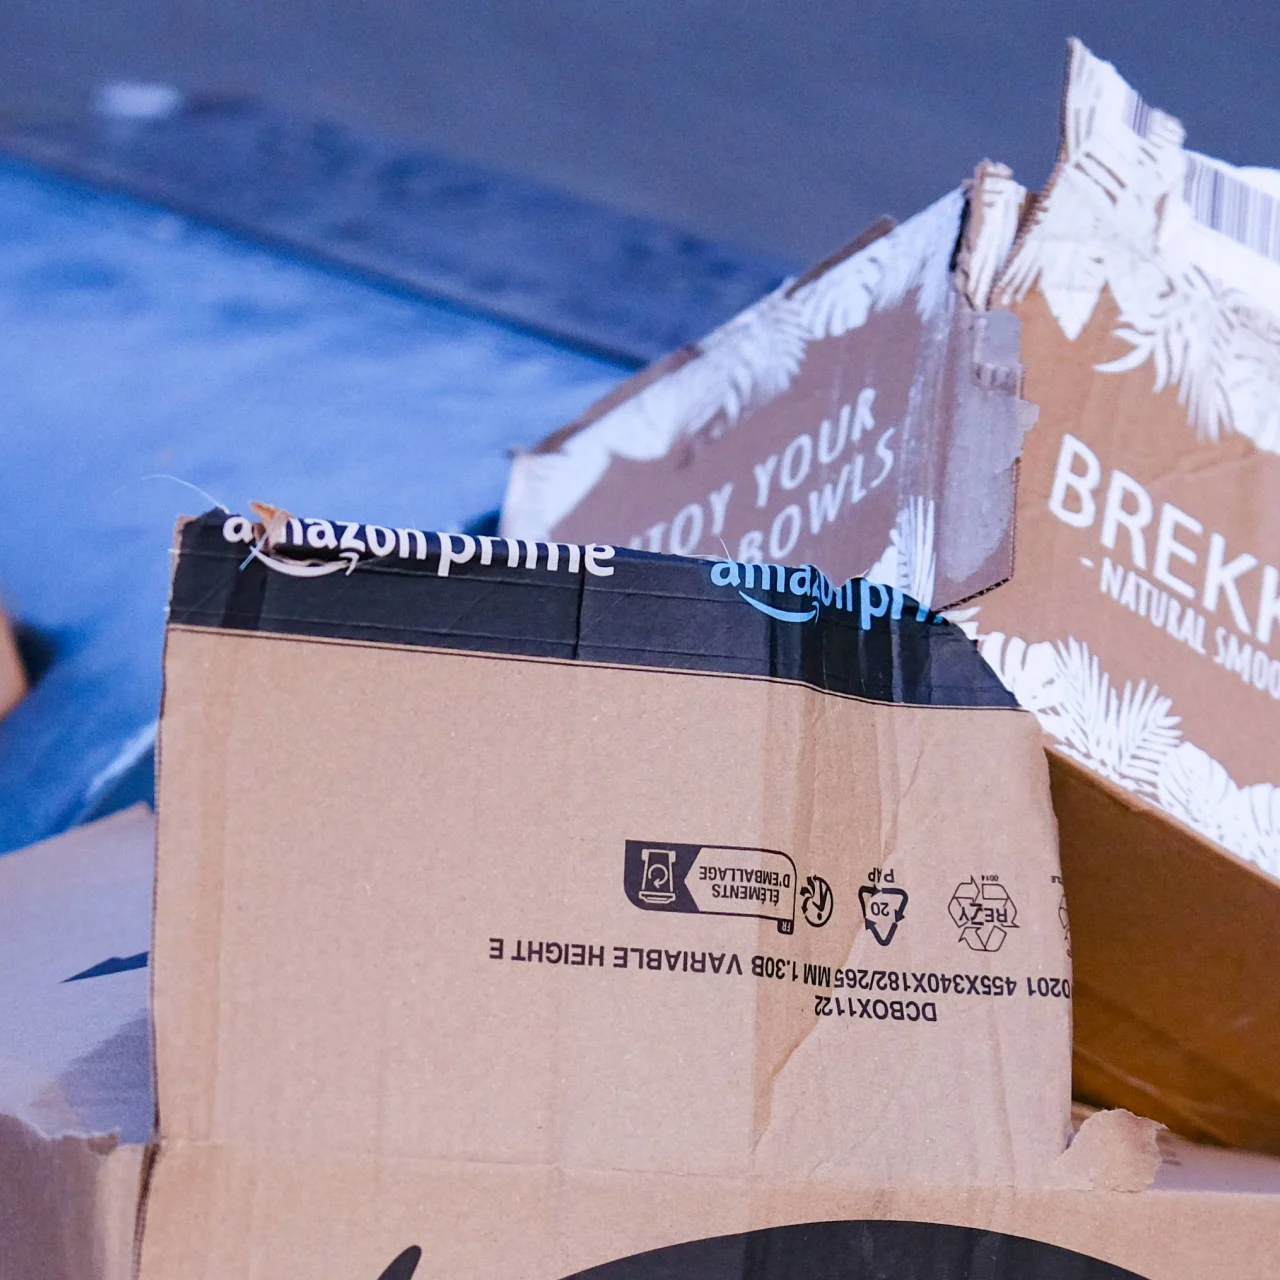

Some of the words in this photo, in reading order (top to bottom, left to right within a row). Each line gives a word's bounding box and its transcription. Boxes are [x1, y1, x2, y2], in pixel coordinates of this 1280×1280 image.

[753, 388, 877, 508] YOUR
[738, 427, 896, 563] BOWLS
[436, 531, 615, 577] prime
[1100, 557, 1208, 656] NATURAL
[698, 866, 791, 888] D'EMBALLAGE
[867, 867, 895, 883] PAP
[711, 883, 780, 907] ÉLÉMENTS
[870, 901, 890, 916] 20
[959, 903, 1008, 926] REZY
[781, 921, 792, 931] FR
[488, 937, 504, 959] E
[511, 939, 605, 967] HEIGHT
[613, 946, 743, 976] VARIABLE
[751, 954, 799, 982] 1.30B
[803, 963, 831, 988] MM
[834, 968, 1018, 996] 455X340X182/265
[1027, 977, 1071, 999] 0201
[814, 994, 938, 1021] DCBOX1122
